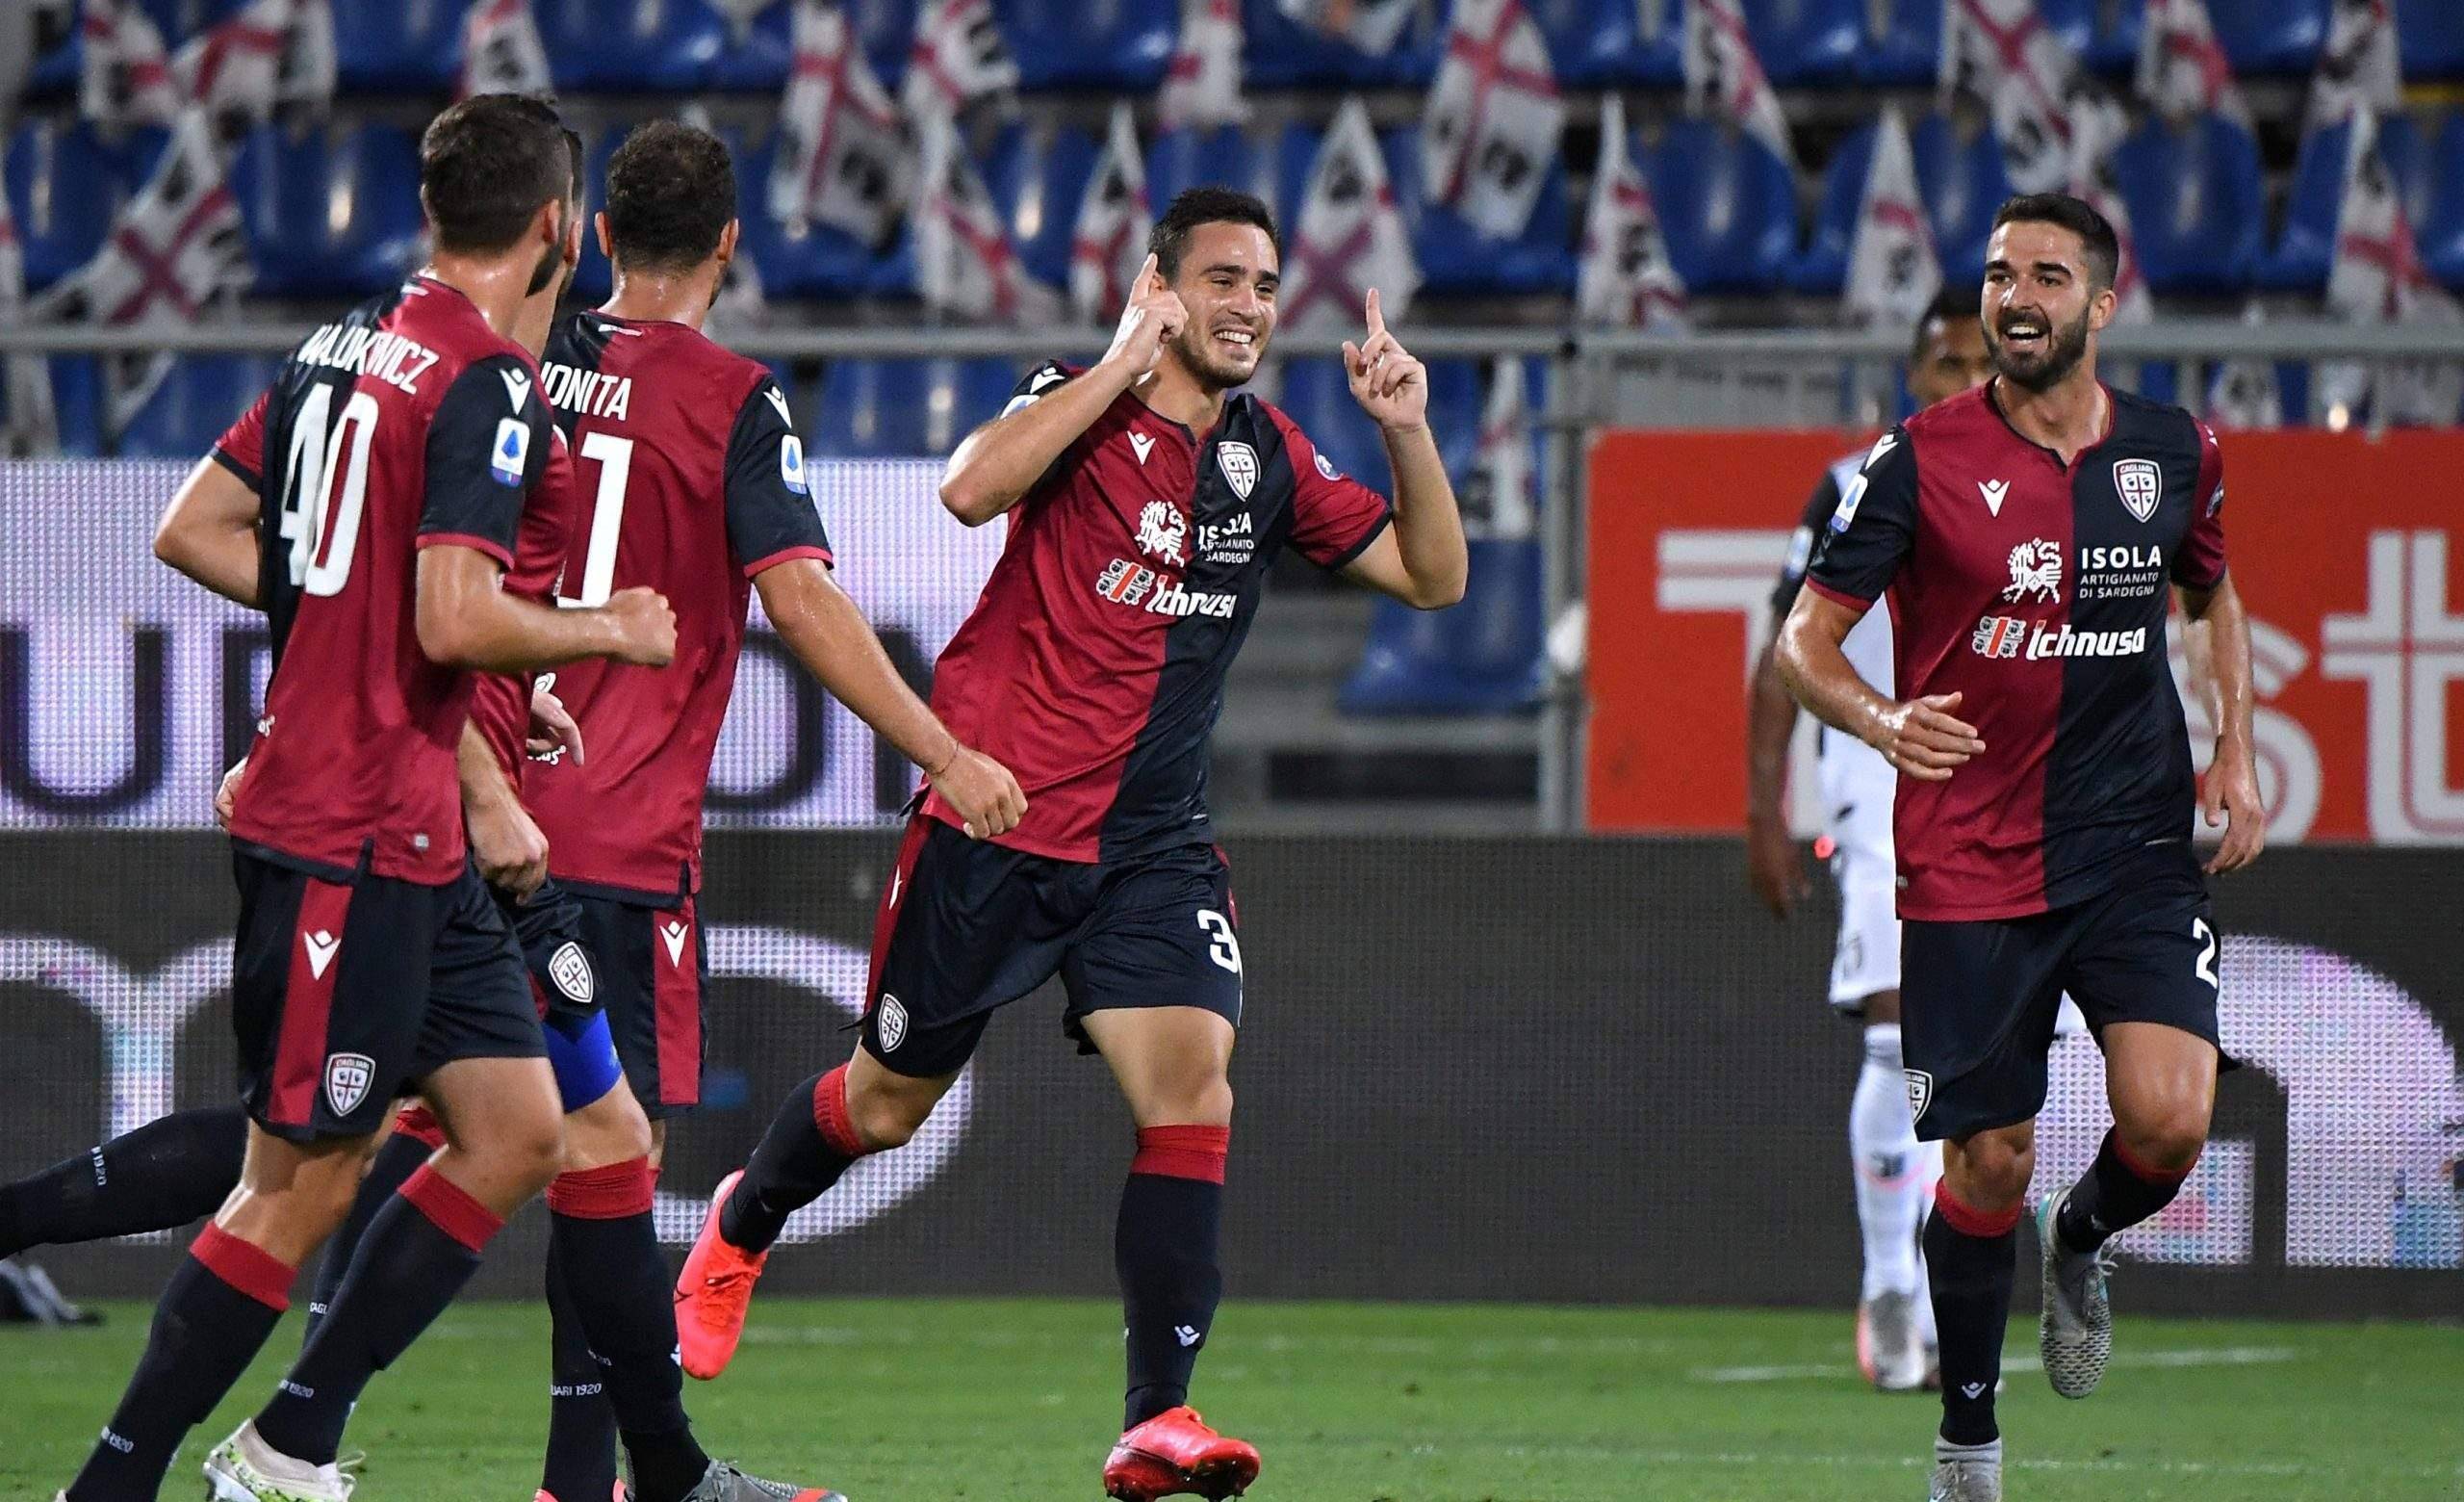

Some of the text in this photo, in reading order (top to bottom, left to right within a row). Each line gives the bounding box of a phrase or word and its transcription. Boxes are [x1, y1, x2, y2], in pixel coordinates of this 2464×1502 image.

[279, 382, 379, 597] 40
[2081, 544, 2162, 571] ISOLA
[2079, 571, 2160, 586] ARTIGIANATO
[2078, 583, 2156, 600] DI SARDEGNA
[576, 1383, 603, 1396] 1920
